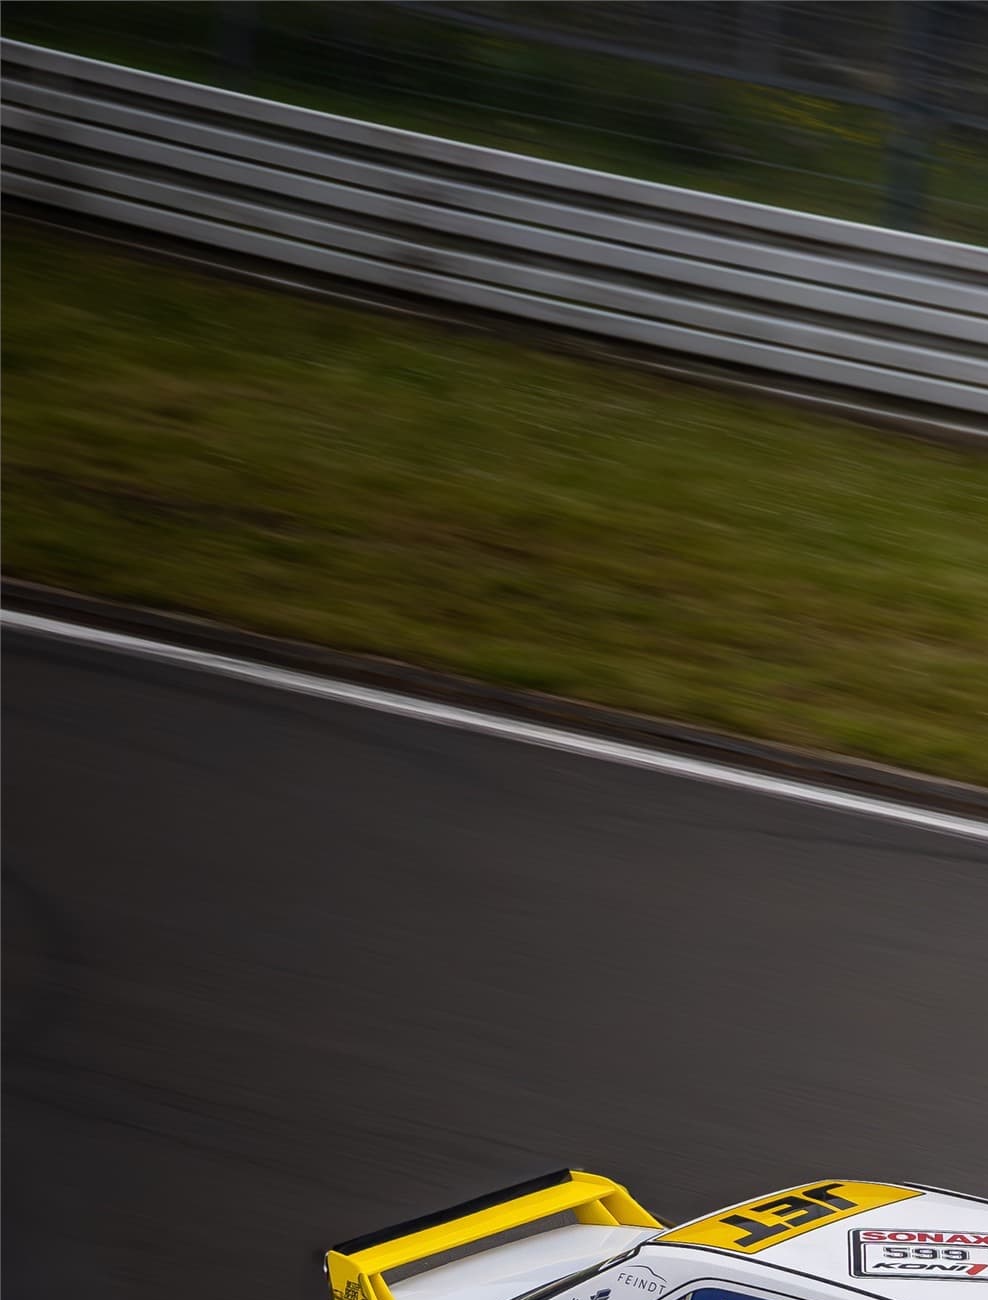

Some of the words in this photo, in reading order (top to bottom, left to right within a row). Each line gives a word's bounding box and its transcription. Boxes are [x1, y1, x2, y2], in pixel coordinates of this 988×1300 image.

[720, 1183, 858, 1247] JET
[883, 1247, 969, 1261] 599
[872, 1262, 972, 1272] KONI
[617, 1273, 666, 1295] FEINDT
